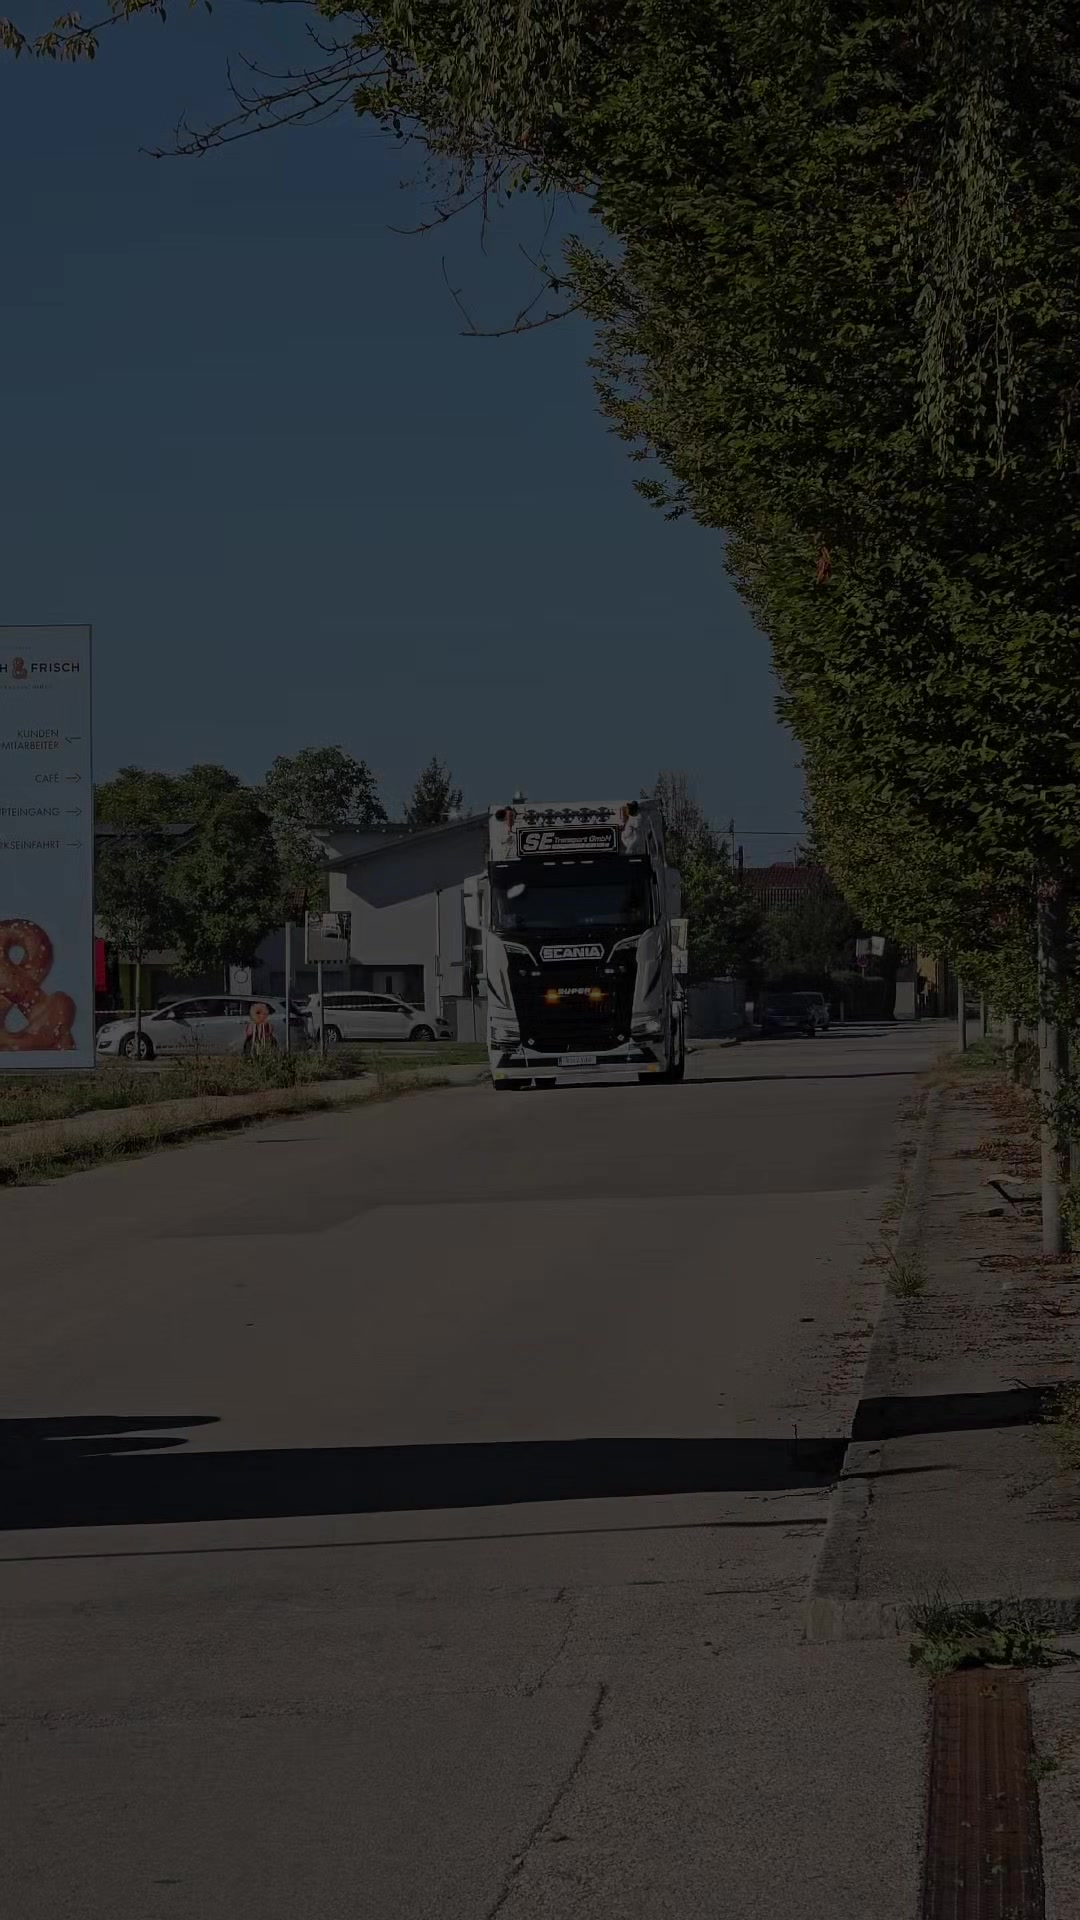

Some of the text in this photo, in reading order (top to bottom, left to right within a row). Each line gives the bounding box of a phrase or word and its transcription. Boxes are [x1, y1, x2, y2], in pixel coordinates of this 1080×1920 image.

[31, 662, 80, 673] FRISCH
[17, 729, 59, 738] KUNDEN
[1, 741, 59, 750] MITARBEITER
[35, 773, 60, 783] CAFÉ
[0, 807, 60, 817] PTEINGANG
[543, 947, 601, 958] SCANIA
[558, 987, 592, 995] SUPER
